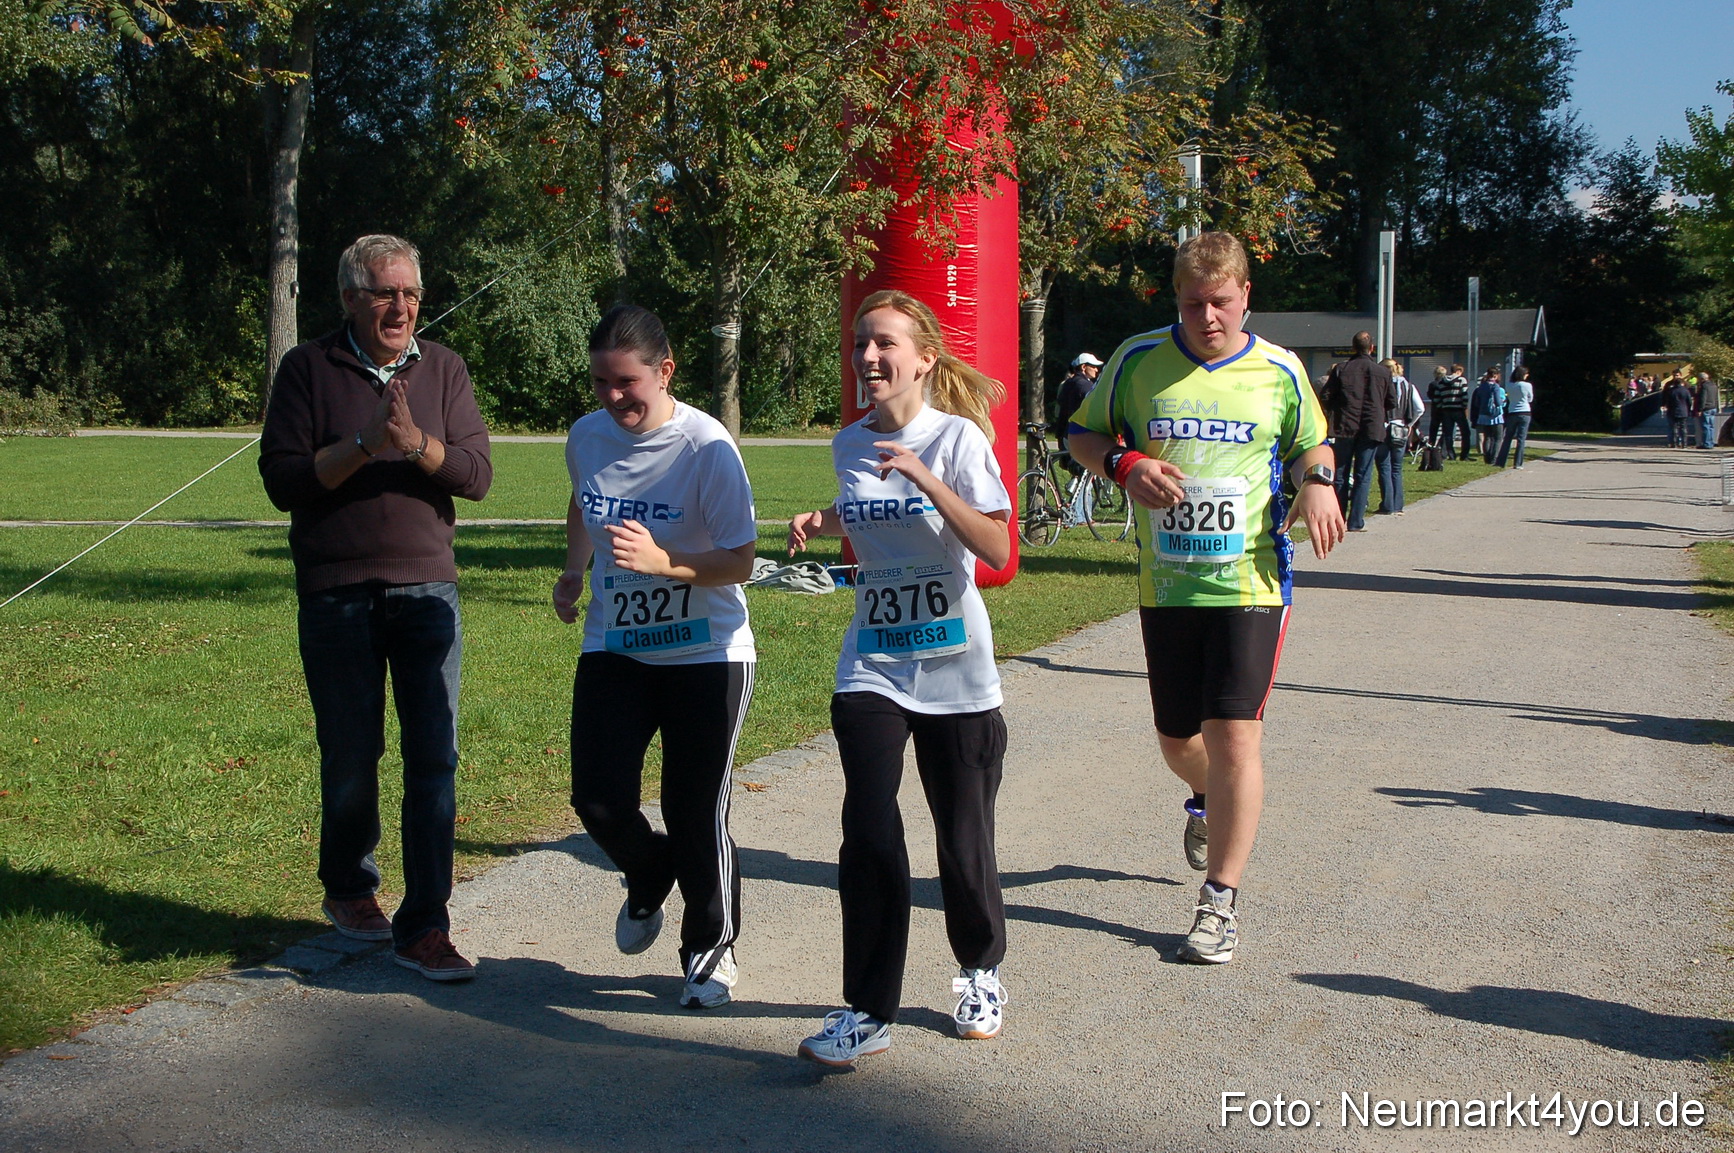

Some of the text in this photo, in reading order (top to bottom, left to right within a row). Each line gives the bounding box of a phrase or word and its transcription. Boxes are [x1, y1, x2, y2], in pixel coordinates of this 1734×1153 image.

[947, 264, 957, 287] 1929
[1151, 398, 1219, 415] TEAM
[1148, 418, 1258, 443] BOCK
[581, 491, 649, 522] PETER
[1163, 501, 1235, 531] 3326
[848, 522, 912, 533] electronic
[1168, 534, 1228, 551] Manuel
[613, 584, 692, 627] 2327
[864, 581, 949, 625] 2376
[623, 624, 692, 649] Claudia
[874, 625, 948, 648] Theresa
